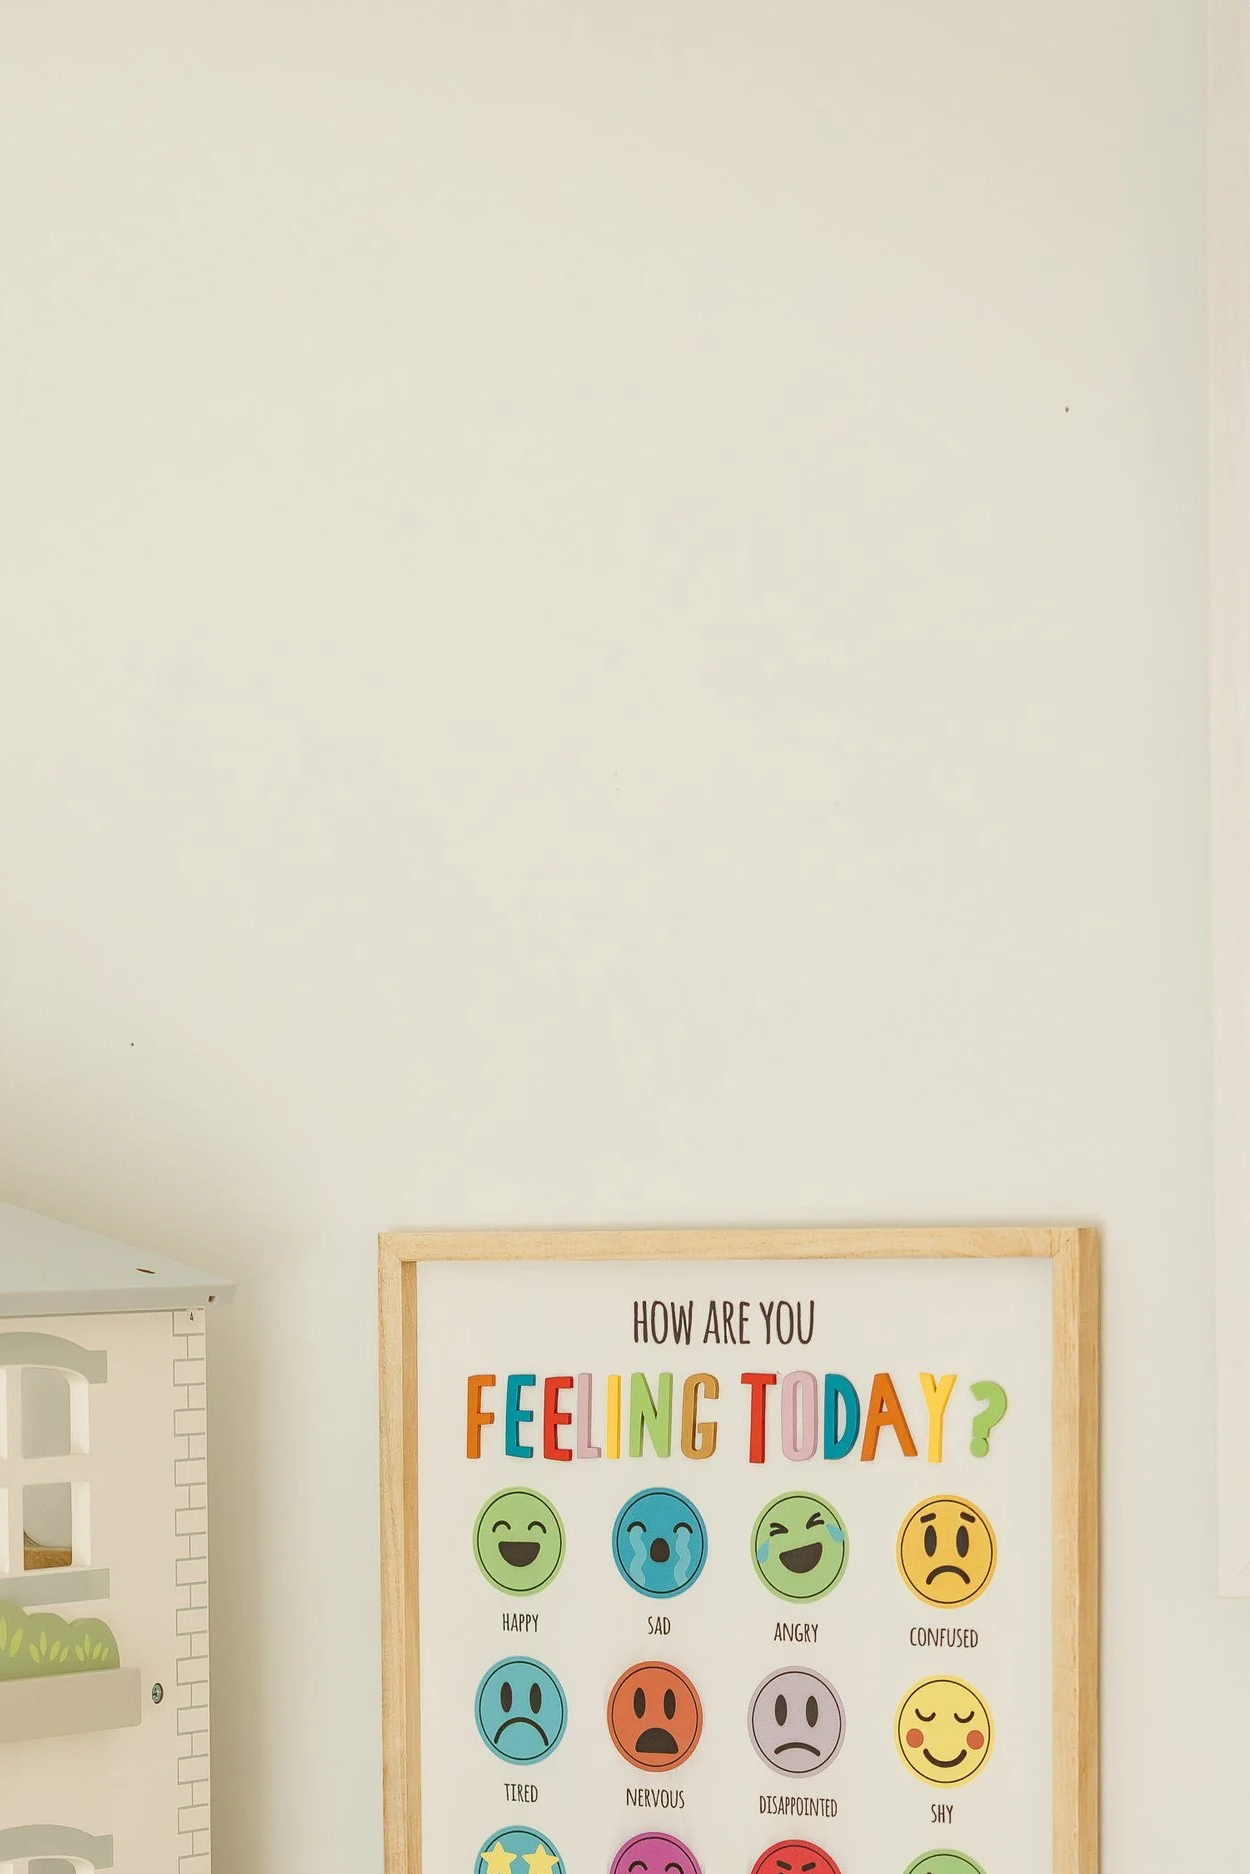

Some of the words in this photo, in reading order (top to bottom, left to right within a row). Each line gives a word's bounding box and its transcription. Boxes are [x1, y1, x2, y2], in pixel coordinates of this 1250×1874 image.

[633, 1300, 694, 1346] HOW
[702, 1300, 751, 1345] ARE
[759, 1299, 815, 1345] YOU
[466, 1373, 719, 1461] FEELING
[741, 1372, 1008, 1463] TODAY?
[502, 1612, 539, 1633] HAPPY
[647, 1616, 671, 1636] SAD
[773, 1622, 819, 1643] ANGRY
[909, 1627, 979, 1648] CONFUSED
[503, 1783, 539, 1803] TIRED
[626, 1788, 685, 1809] NERVOUS
[759, 1795, 838, 1818] DISAPPOINTED
[930, 1803, 954, 1824] SHY
